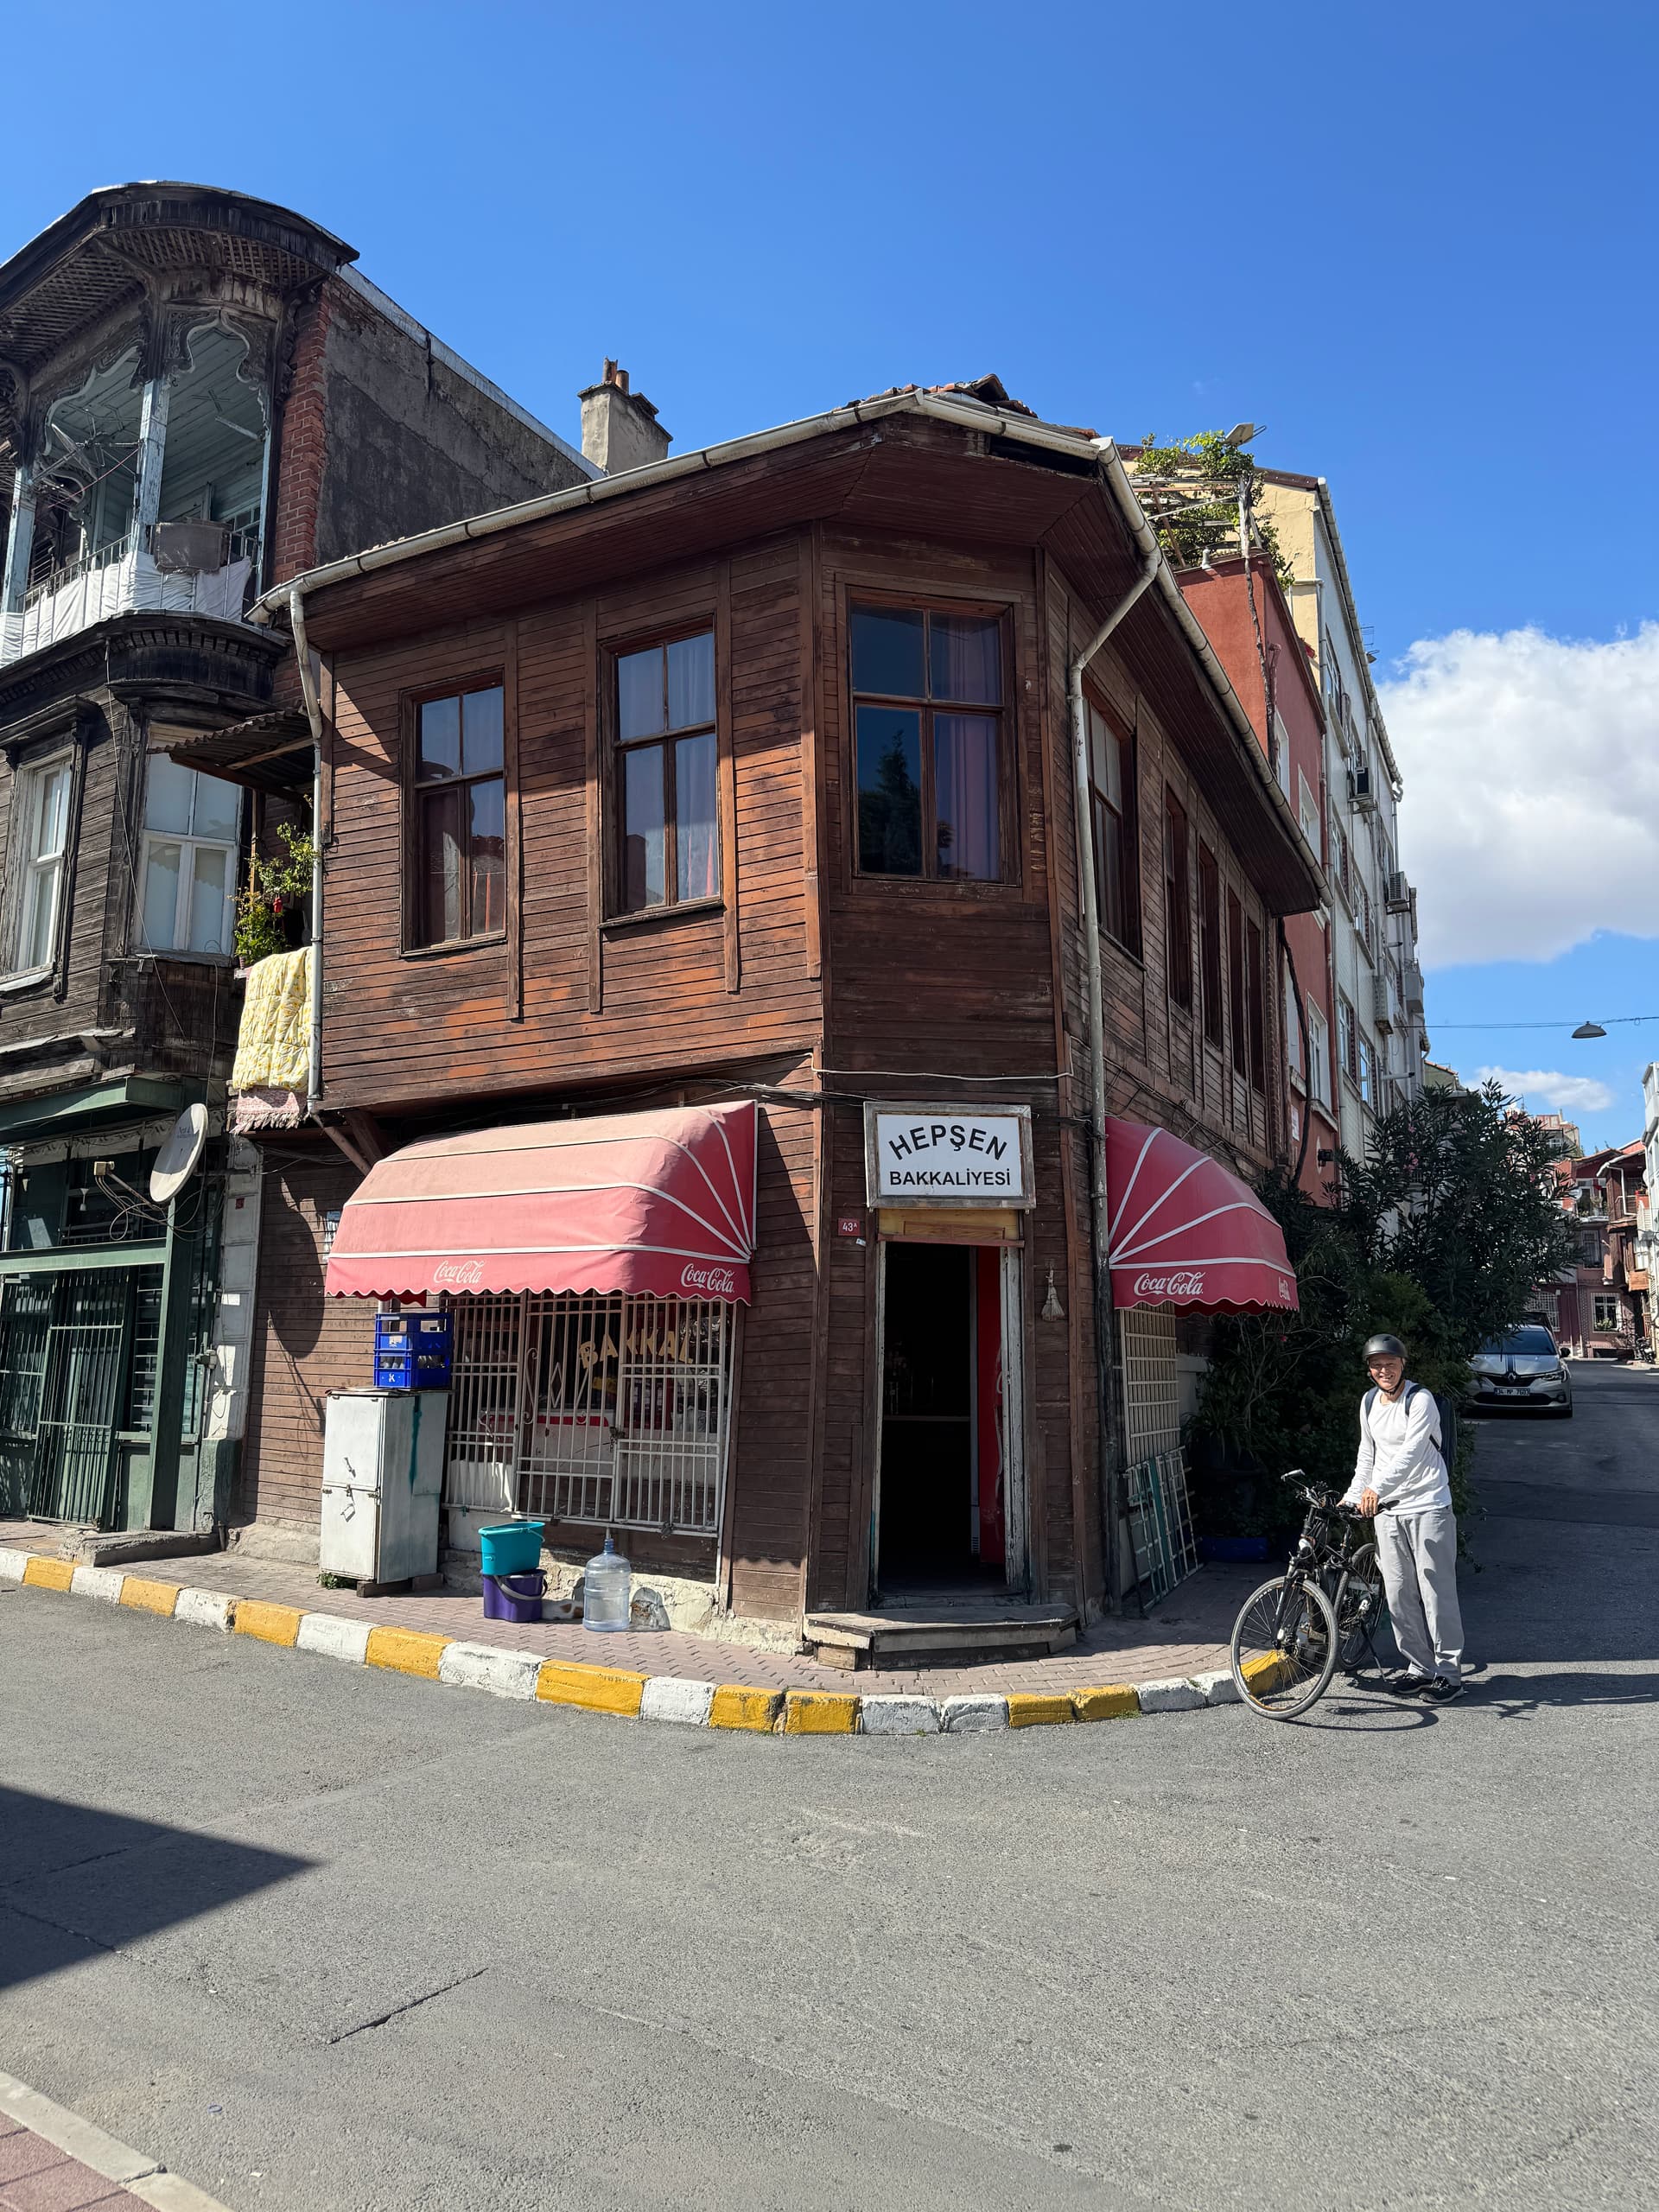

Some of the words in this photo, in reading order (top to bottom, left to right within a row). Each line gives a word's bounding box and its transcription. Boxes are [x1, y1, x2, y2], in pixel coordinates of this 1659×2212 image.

[888, 1124, 1007, 1160] HEPŞEN
[889, 1168, 1011, 1185] BAKKALİYESİ
[579, 1328, 694, 1370] BAKKAL
